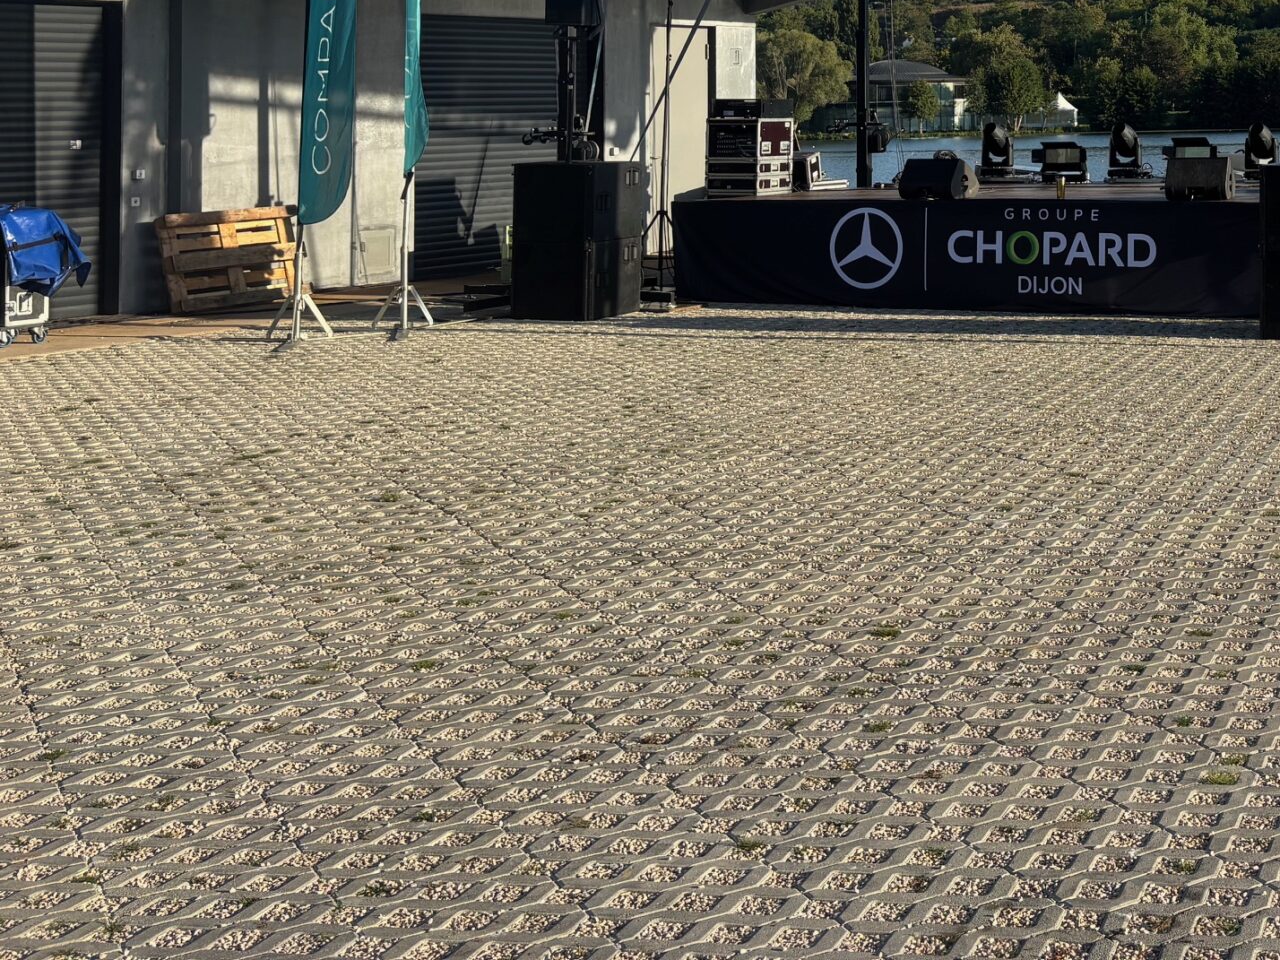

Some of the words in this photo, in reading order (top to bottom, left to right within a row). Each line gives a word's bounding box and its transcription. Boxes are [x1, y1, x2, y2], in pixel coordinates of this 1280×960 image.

[1004, 208, 1100, 221] GROUPE
[948, 229, 1157, 268] CHOPARD
[1018, 275, 1082, 295] DIJON
